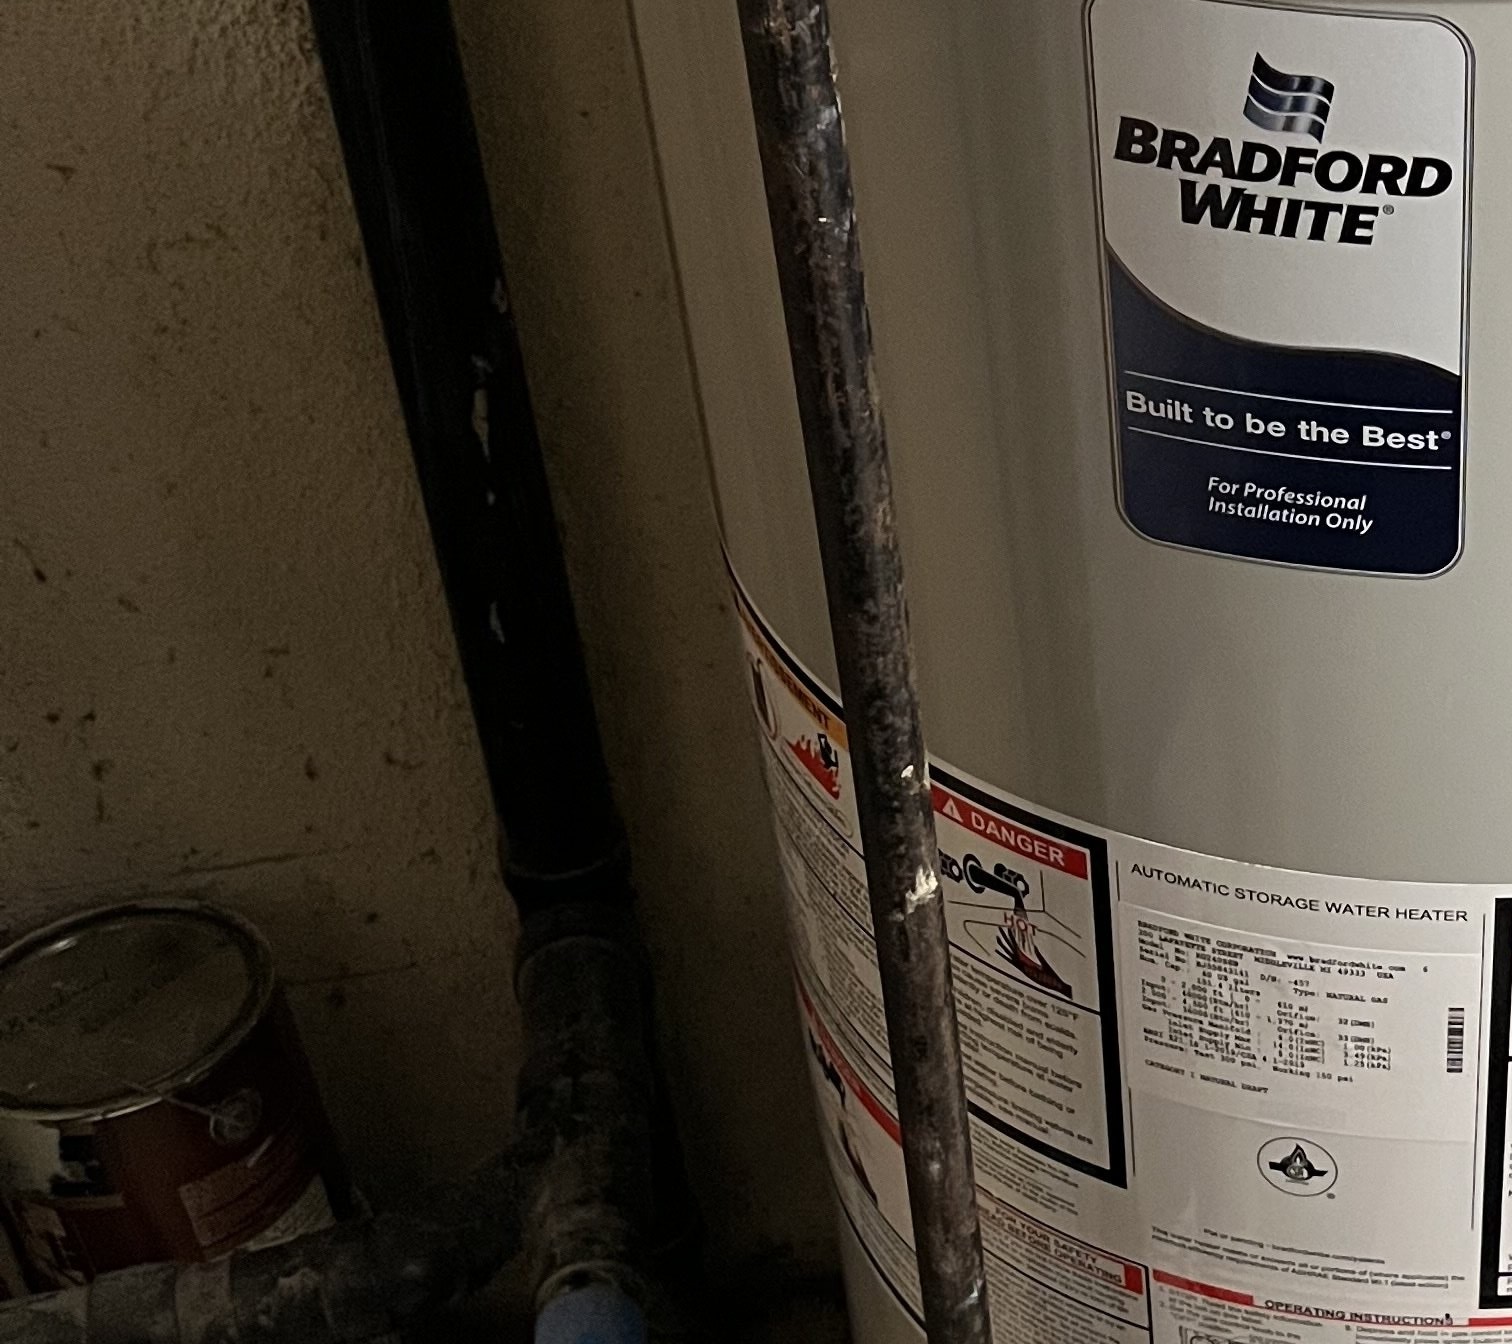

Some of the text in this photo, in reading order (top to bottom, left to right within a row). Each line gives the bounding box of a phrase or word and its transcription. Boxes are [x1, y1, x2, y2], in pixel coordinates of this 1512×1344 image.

[1113, 116, 1452, 197] BRADFORD
[1125, 390, 1194, 425] Built
[1203, 405, 1234, 430] to
[1246, 412, 1285, 438] be
[1298, 420, 1349, 444] the
[1208, 478, 1367, 510] For Professional
[1208, 497, 1373, 534] Installation Only
[971, 811, 1065, 866] DANGER
[1131, 863, 1468, 922] AUTOMATIC STORAGE WATER HEATER
[1004, 912, 1036, 936] HOT
[1264, 1299, 1345, 1320] OPERATING
